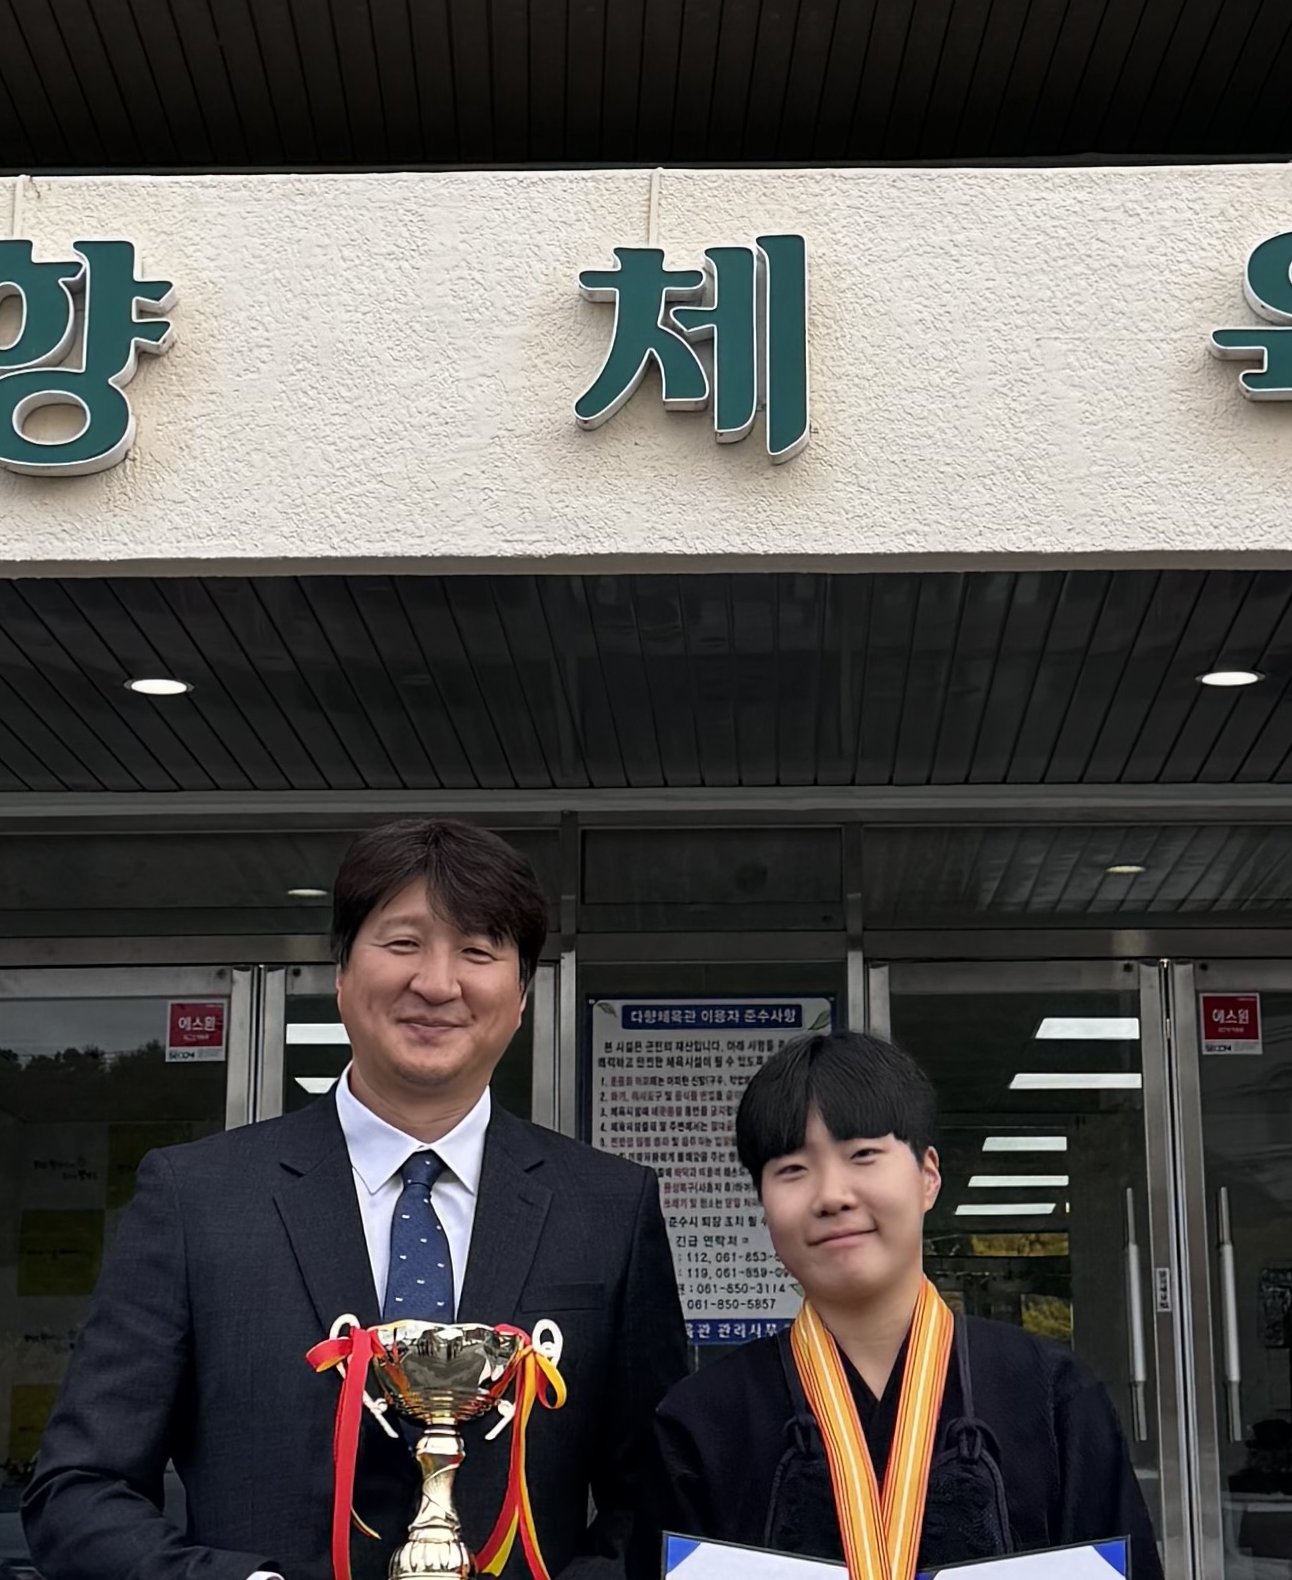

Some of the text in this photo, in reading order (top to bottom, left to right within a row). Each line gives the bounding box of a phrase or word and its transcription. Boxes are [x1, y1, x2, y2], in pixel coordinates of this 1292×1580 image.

[178, 1016, 216, 1031] 에스원
[630, 1007, 796, 1024] 다향체육관 이용자 준수사항
[1211, 1008, 1249, 1024] 에스원
